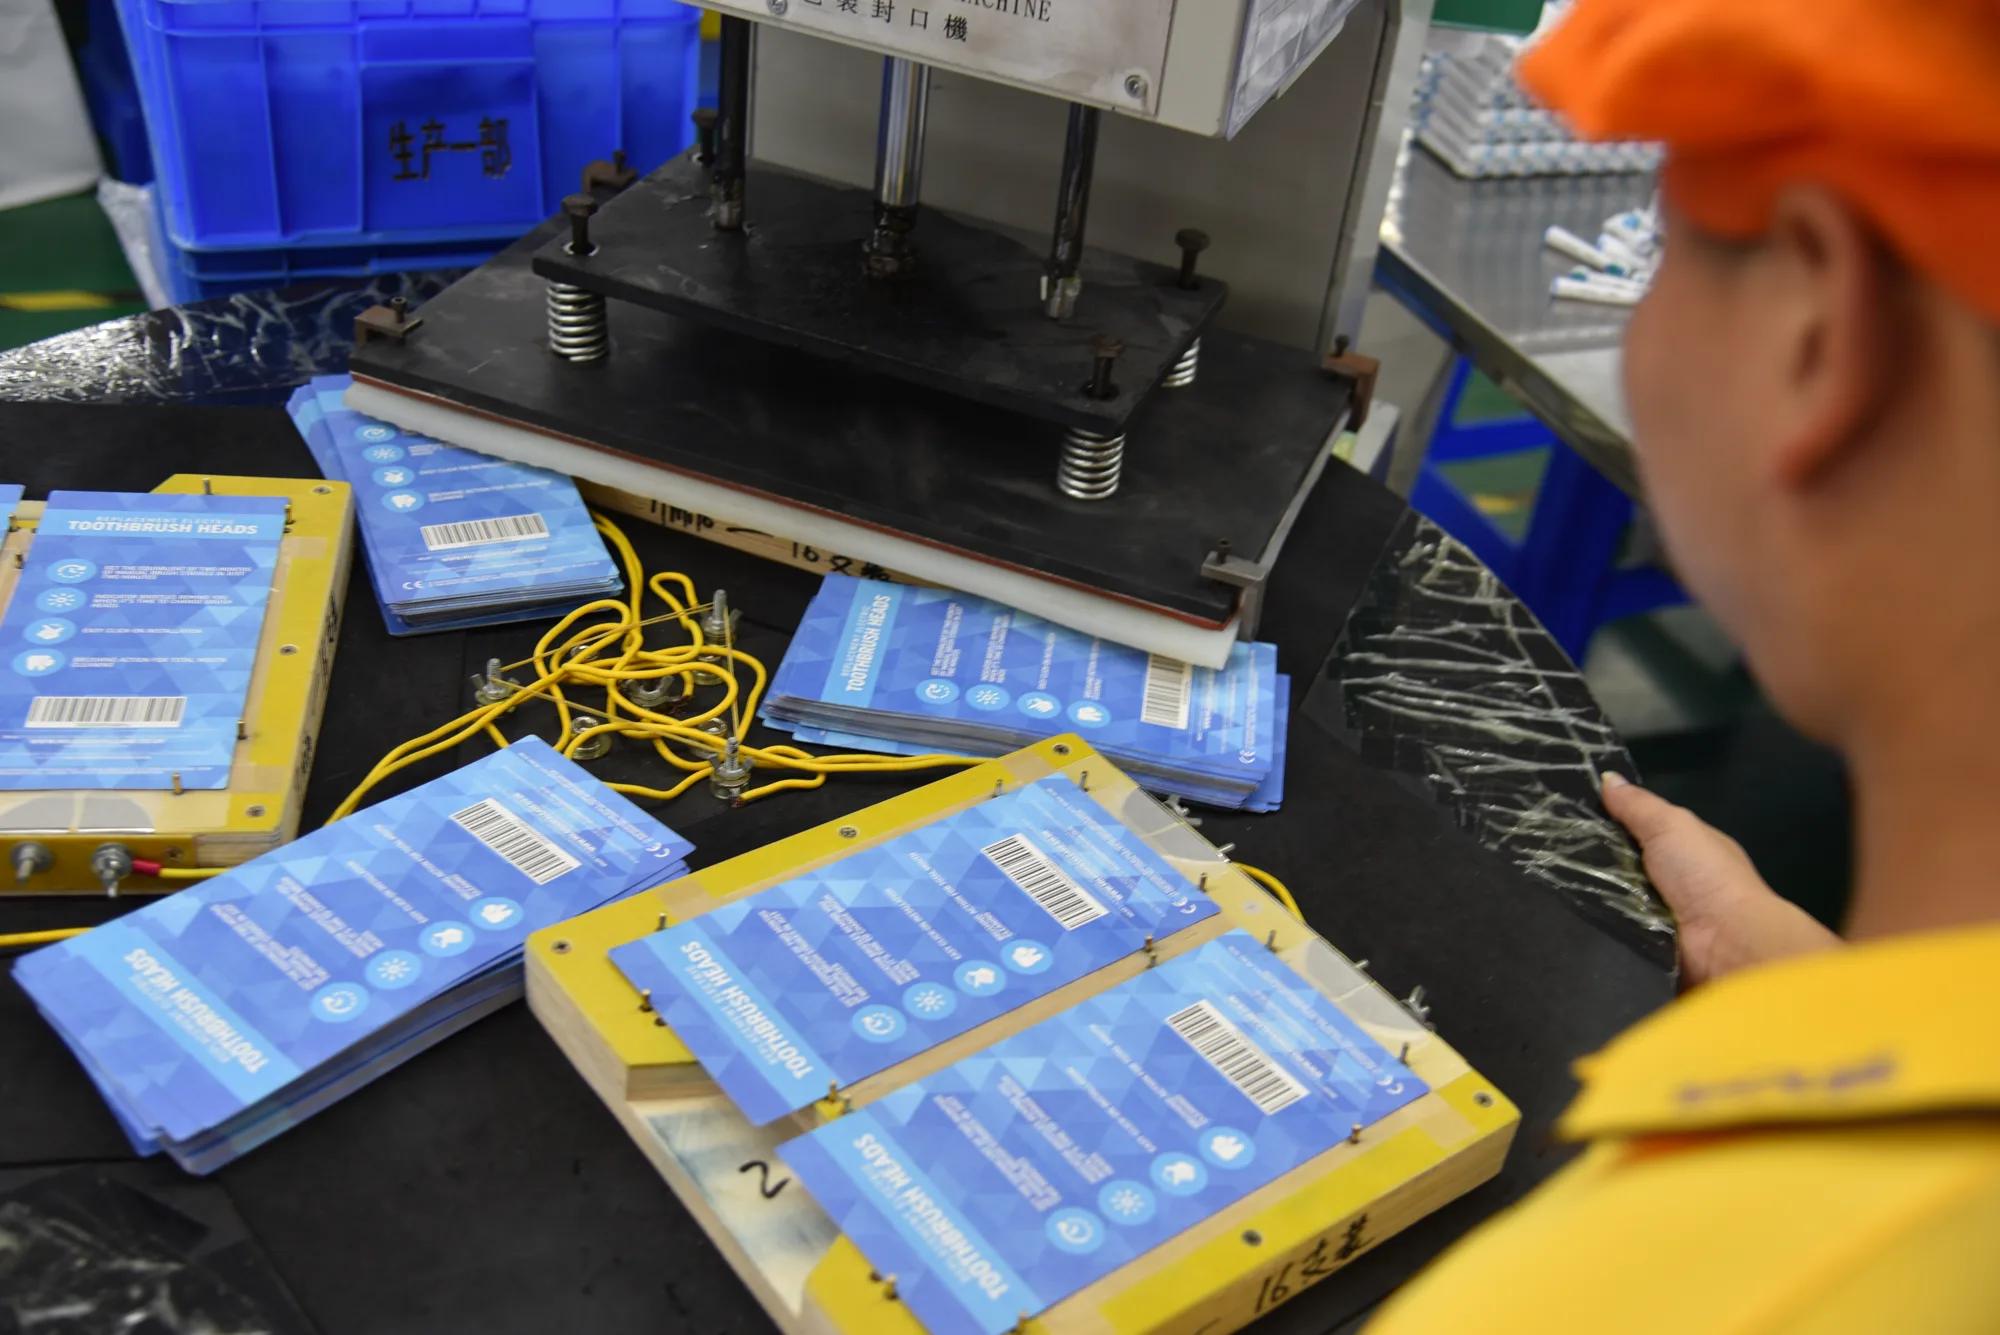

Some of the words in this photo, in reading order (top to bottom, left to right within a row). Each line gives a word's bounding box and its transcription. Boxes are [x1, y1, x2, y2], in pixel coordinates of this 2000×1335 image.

[389, 116, 512, 181] 生产一部
[66, 520, 192, 532] TOOTHBRUSH
[197, 524, 258, 534] HEADS
[844, 627, 881, 692] TOOTHBRUSH
[866, 594, 891, 626] HEADS
[121, 946, 181, 993] HEADS
[678, 939, 733, 988] HEADS
[168, 987, 271, 1072] TOOTHBRUSH
[719, 984, 816, 1079] TOOTHBRUSH
[850, 1131, 914, 1190] HEADS
[899, 1184, 1012, 1300] TOOTHBRUSH
